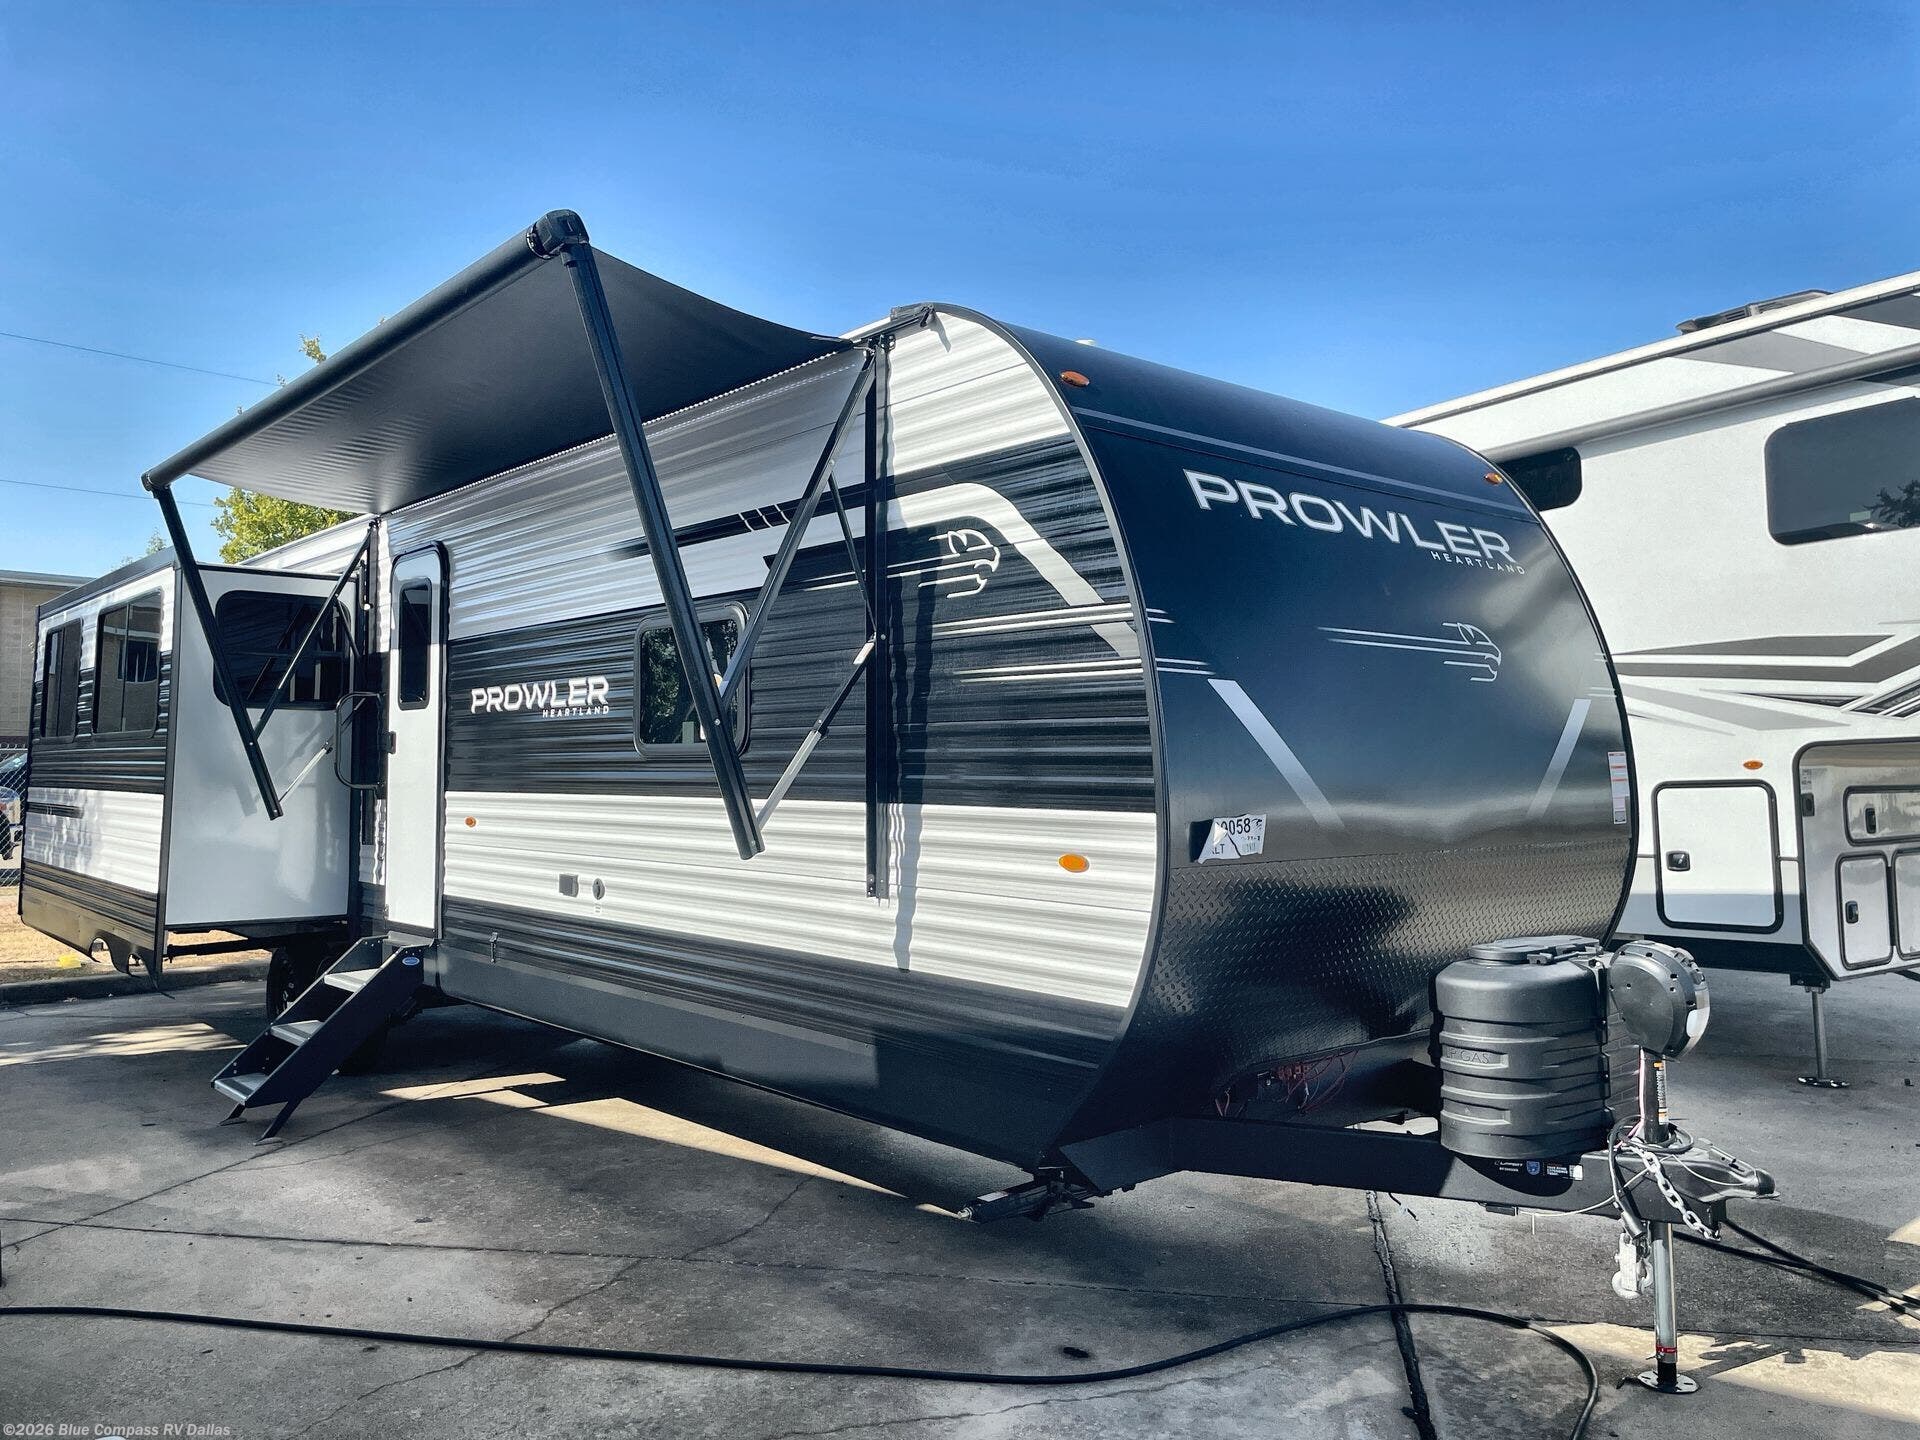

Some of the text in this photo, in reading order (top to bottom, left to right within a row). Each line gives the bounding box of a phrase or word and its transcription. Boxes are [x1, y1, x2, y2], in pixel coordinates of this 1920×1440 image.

[1183, 469, 1516, 563] PROWLER
[1430, 550, 1526, 575] HEARTLAND
[471, 675, 610, 714] PROWLER
[542, 705, 610, 718] HEARTLAND
[1461, 1050, 1489, 1065] GAS
